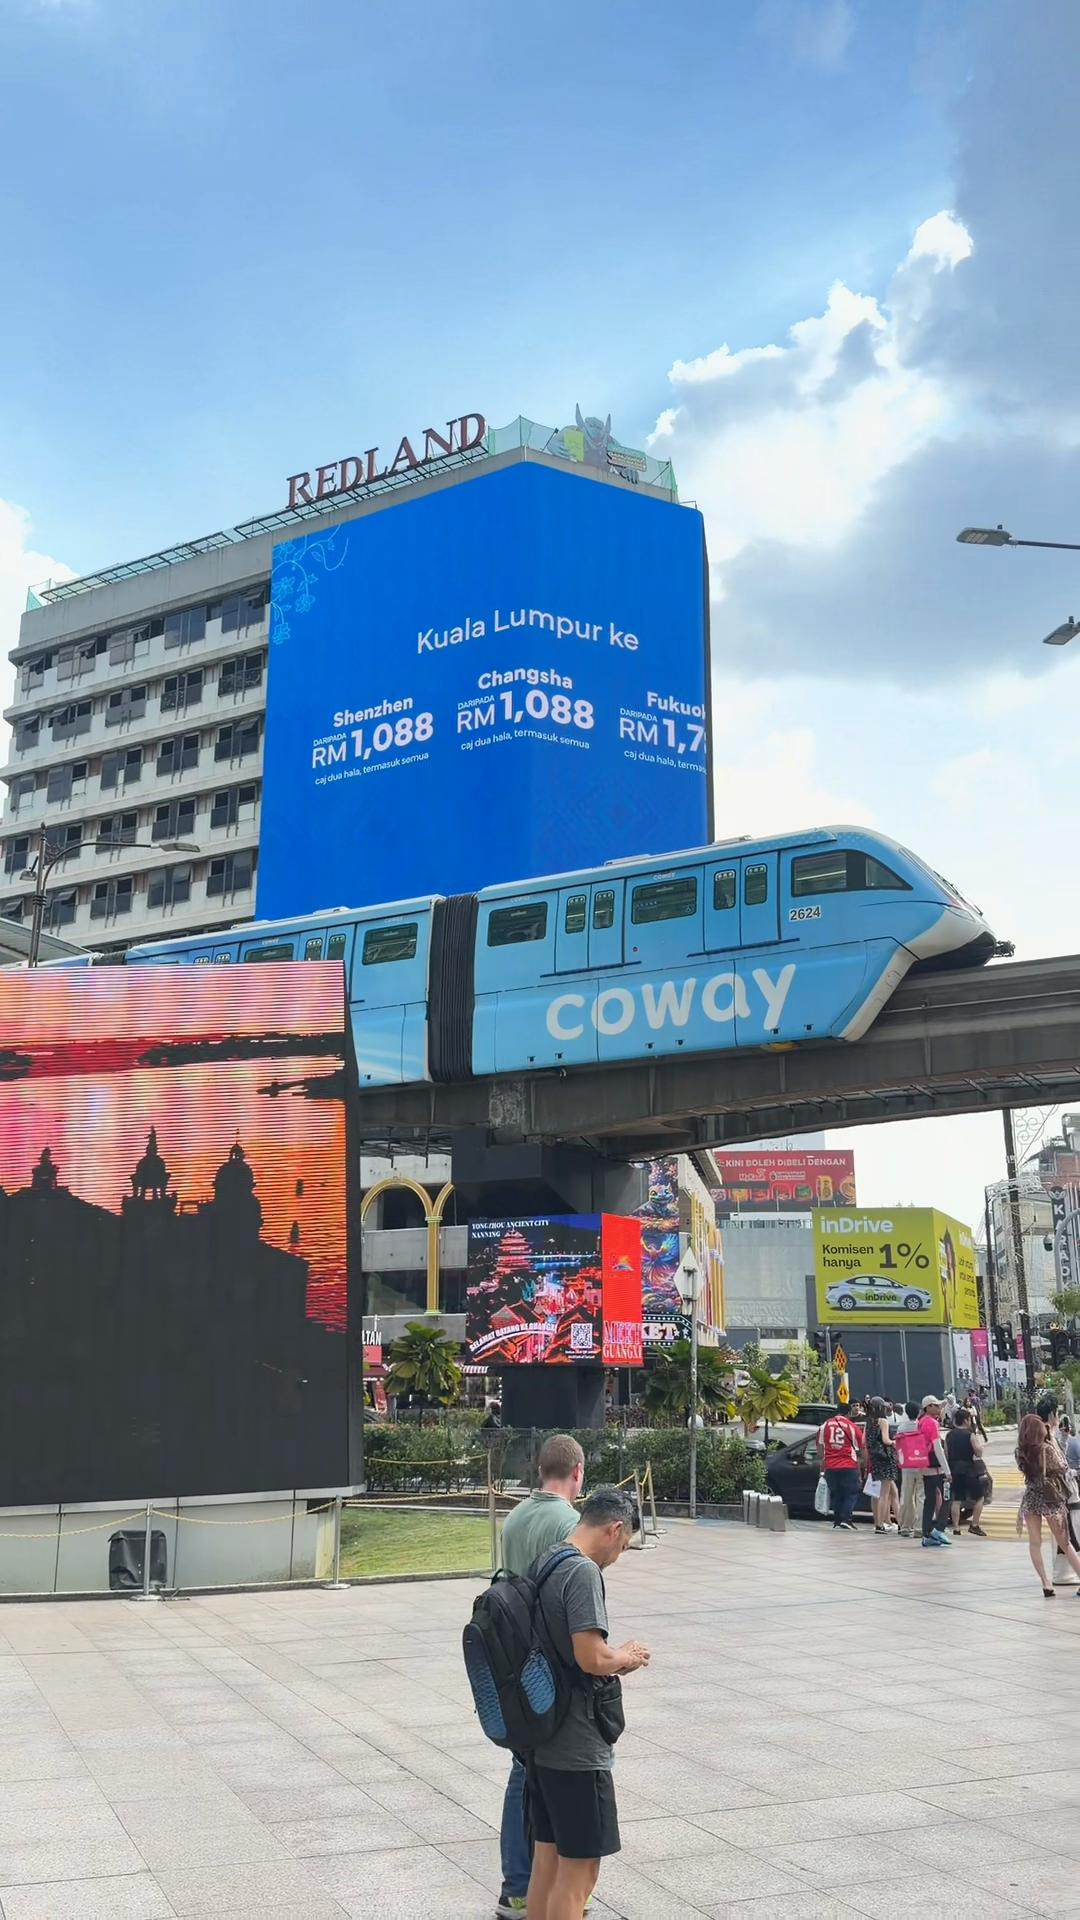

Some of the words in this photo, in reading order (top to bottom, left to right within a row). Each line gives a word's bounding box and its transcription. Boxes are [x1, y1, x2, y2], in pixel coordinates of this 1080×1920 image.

[286, 413, 486, 509] REDLAND
[417, 617, 485, 654] Kuala
[494, 608, 602, 641] Lumpur
[609, 622, 639, 651] ke
[478, 667, 573, 689] Changsha
[457, 695, 495, 710] DARIPADA
[457, 704, 495, 733] RM
[500, 689, 595, 730] 1,088
[333, 697, 413, 727] Shenzhen
[620, 708, 658, 722] DARIPADA
[312, 741, 347, 769] RM
[351, 712, 434, 760] 1,088
[313, 733, 347, 747] DARIPADA
[461, 737, 474, 751] caj
[474, 734, 491, 748] dua
[492, 731, 513, 746] hala,
[514, 729, 558, 743] termasuk
[559, 736, 590, 749] semua
[620, 717, 658, 746] RM
[663, 718, 706, 754] 1,7
[624, 750, 637, 760] caj
[638, 751, 655, 762] dua
[656, 755, 676, 768] hala,
[314, 776, 327, 785] caj
[328, 772, 343, 782] dua
[344, 768, 362, 780] hala,
[363, 758, 401, 774] termasuk
[401, 752, 429, 765] semua
[790, 906, 821, 921] 2624
[546, 963, 797, 1041] coway
[725, 1159, 744, 1168] KINI
[746, 1159, 776, 1167] BOLEH
[778, 1159, 806, 1167] DIBELI
[808, 1158, 846, 1167] DENGAN
[506, 1220, 533, 1229] ANCIENT
[533, 1219, 549, 1227] CITY
[820, 1216, 894, 1233] inDrive
[822, 1244, 874, 1255] Komisen
[880, 1242, 930, 1269] 1%
[823, 1257, 862, 1270] hanya
[865, 1293, 897, 1301] inDrive
[603, 1344, 642, 1359] GUANGXI
[829, 1426, 845, 1444] 12
